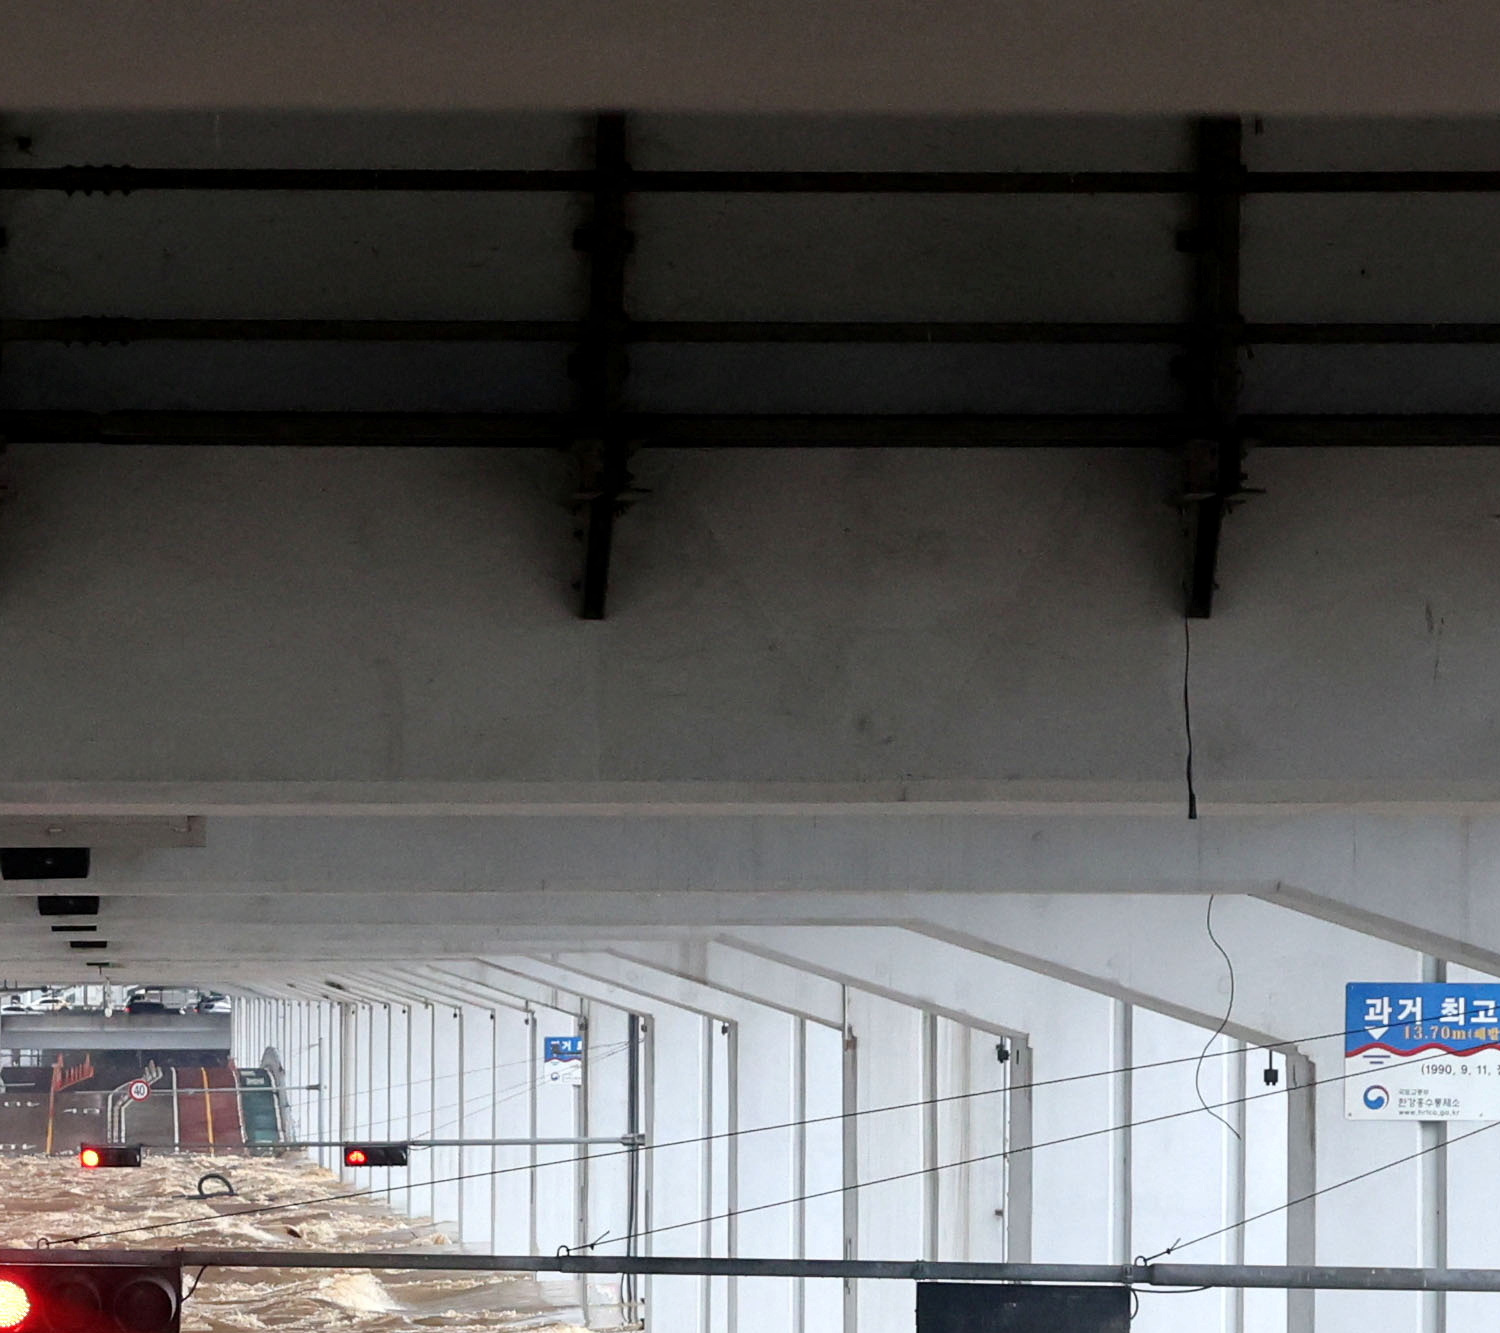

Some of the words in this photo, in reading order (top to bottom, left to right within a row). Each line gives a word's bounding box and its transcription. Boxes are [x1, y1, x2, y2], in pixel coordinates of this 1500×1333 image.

[1364, 996, 1422, 1025] 과거
[1439, 997, 1498, 1026] 최고
[134, 1084, 146, 1096] 40
